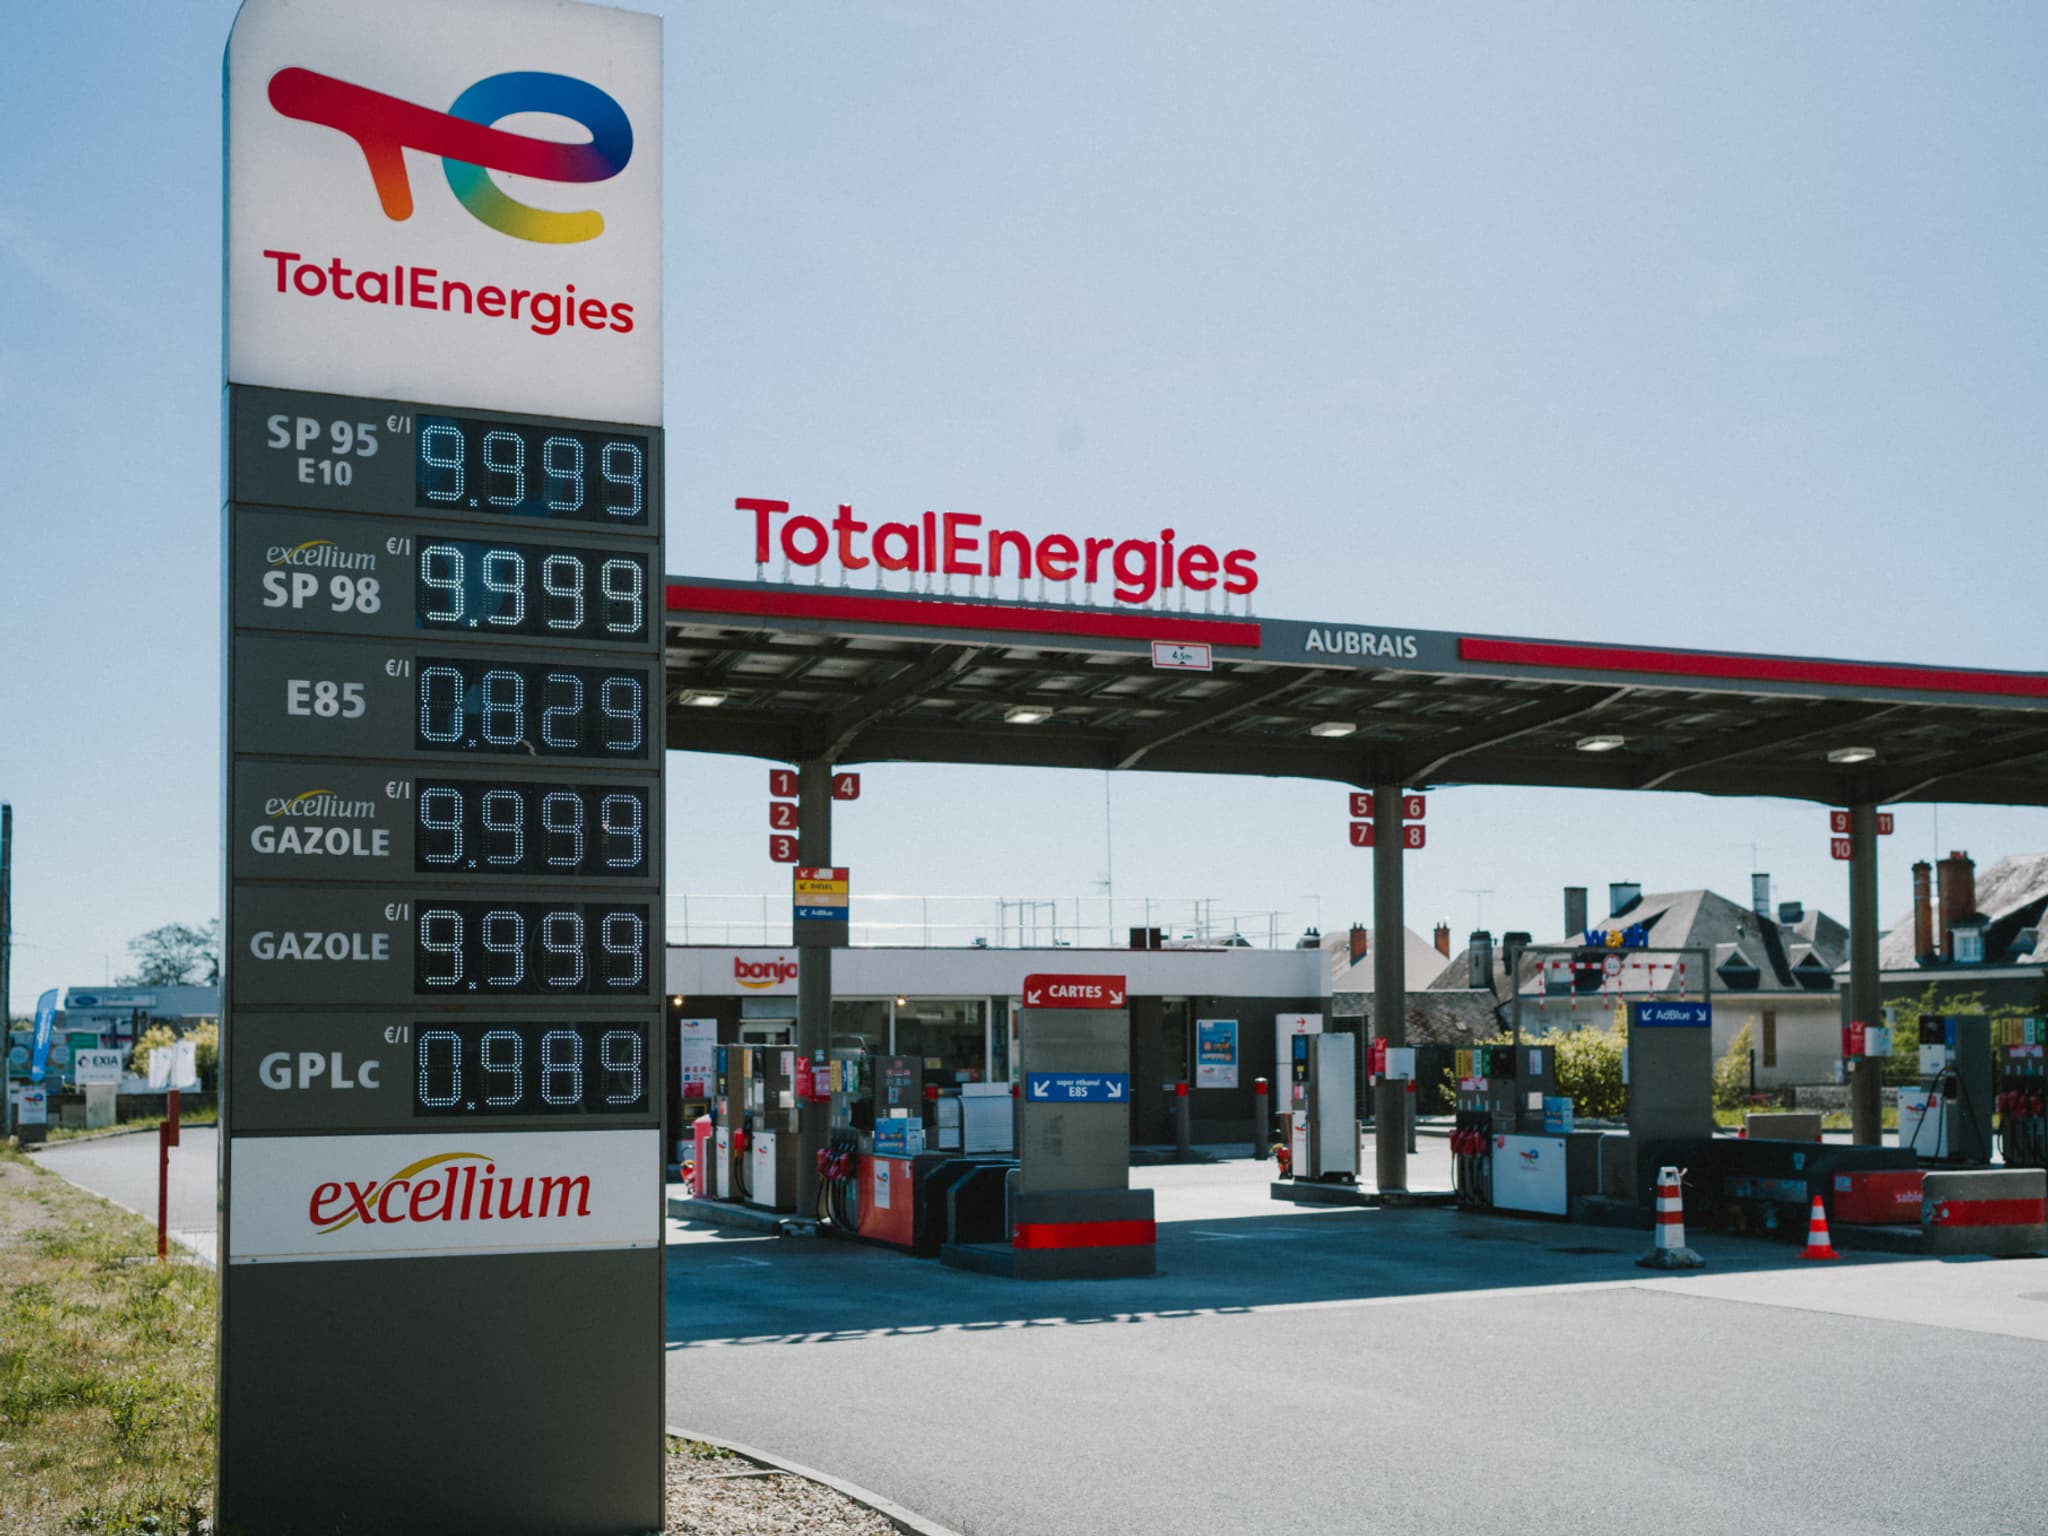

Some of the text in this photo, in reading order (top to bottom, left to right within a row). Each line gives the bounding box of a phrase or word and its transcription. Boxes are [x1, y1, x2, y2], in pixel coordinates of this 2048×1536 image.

[263, 249, 634, 336] TotalEnergies
[266, 414, 379, 457] SP 95
[297, 458, 353, 487] E10
[421, 425, 642, 517] 9.999
[266, 542, 377, 571] excellium
[735, 497, 1259, 604] TotalEnergies
[262, 570, 381, 614] SP 98
[421, 545, 642, 633] 9.999
[1304, 628, 1418, 659] AUBRAIS
[286, 679, 366, 719] E85
[420, 666, 642, 751] 0.829
[777, 774, 788, 793] 1
[840, 776, 854, 796] 4
[264, 791, 376, 818] excellium
[777, 805, 791, 826] 2
[1357, 795, 1368, 815] 5
[1409, 798, 1421, 817] 6
[420, 787, 642, 869] 9.999
[1357, 825, 1368, 843] 7
[1409, 827, 1421, 846] 8
[1836, 813, 1847, 831] 9
[1879, 814, 1892, 833] 11
[250, 826, 390, 857] GAZOLE
[777, 838, 790, 859] 3
[1833, 840, 1851, 858] 10
[250, 931, 390, 961] GAZOLE
[420, 909, 643, 991] 9.999
[734, 955, 799, 985] bonjo
[1048, 984, 1103, 999] CARTES
[1655, 1008, 1691, 1022] AdBlue
[92, 1055, 119, 1066] EXIA
[258, 1051, 380, 1090] GPLc
[419, 1030, 642, 1111] 0.989
[308, 1162, 592, 1227] excellium
